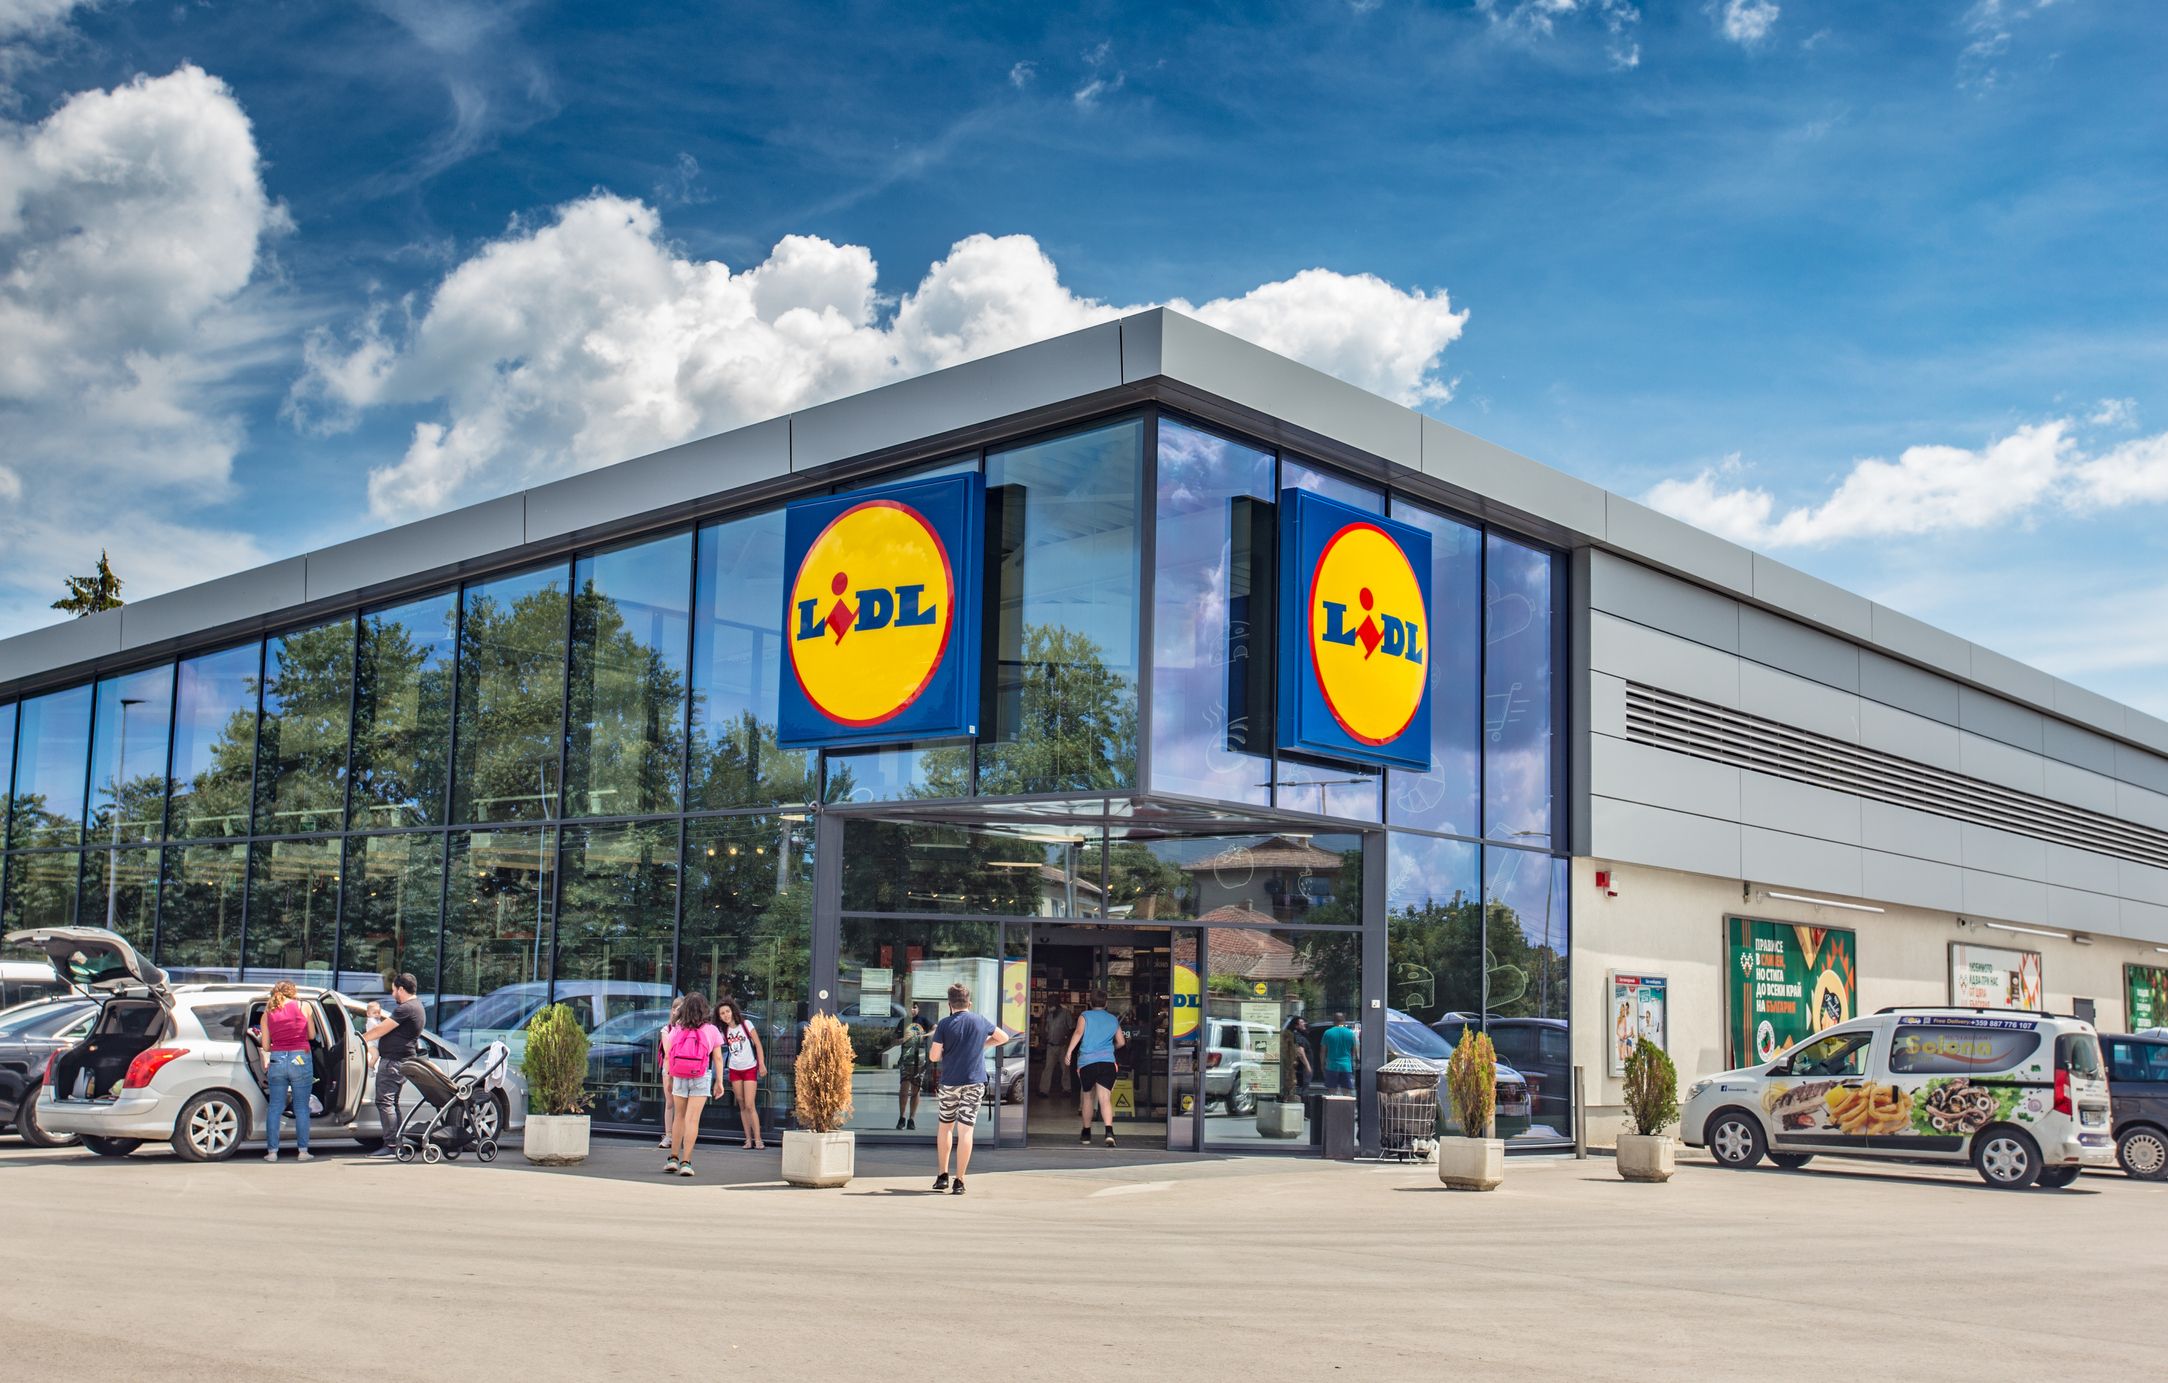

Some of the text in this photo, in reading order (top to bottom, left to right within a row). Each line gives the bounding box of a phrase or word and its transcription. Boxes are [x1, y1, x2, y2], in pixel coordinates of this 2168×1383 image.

[1755, 953, 1760, 966] В
[1756, 968, 1784, 982] НО СТИГА
[1756, 982, 1802, 998] ДО ВСЕКИ КРАЙ
[1756, 999, 1765, 1012] НА
[1971, 1019, 1988, 1027] +359
